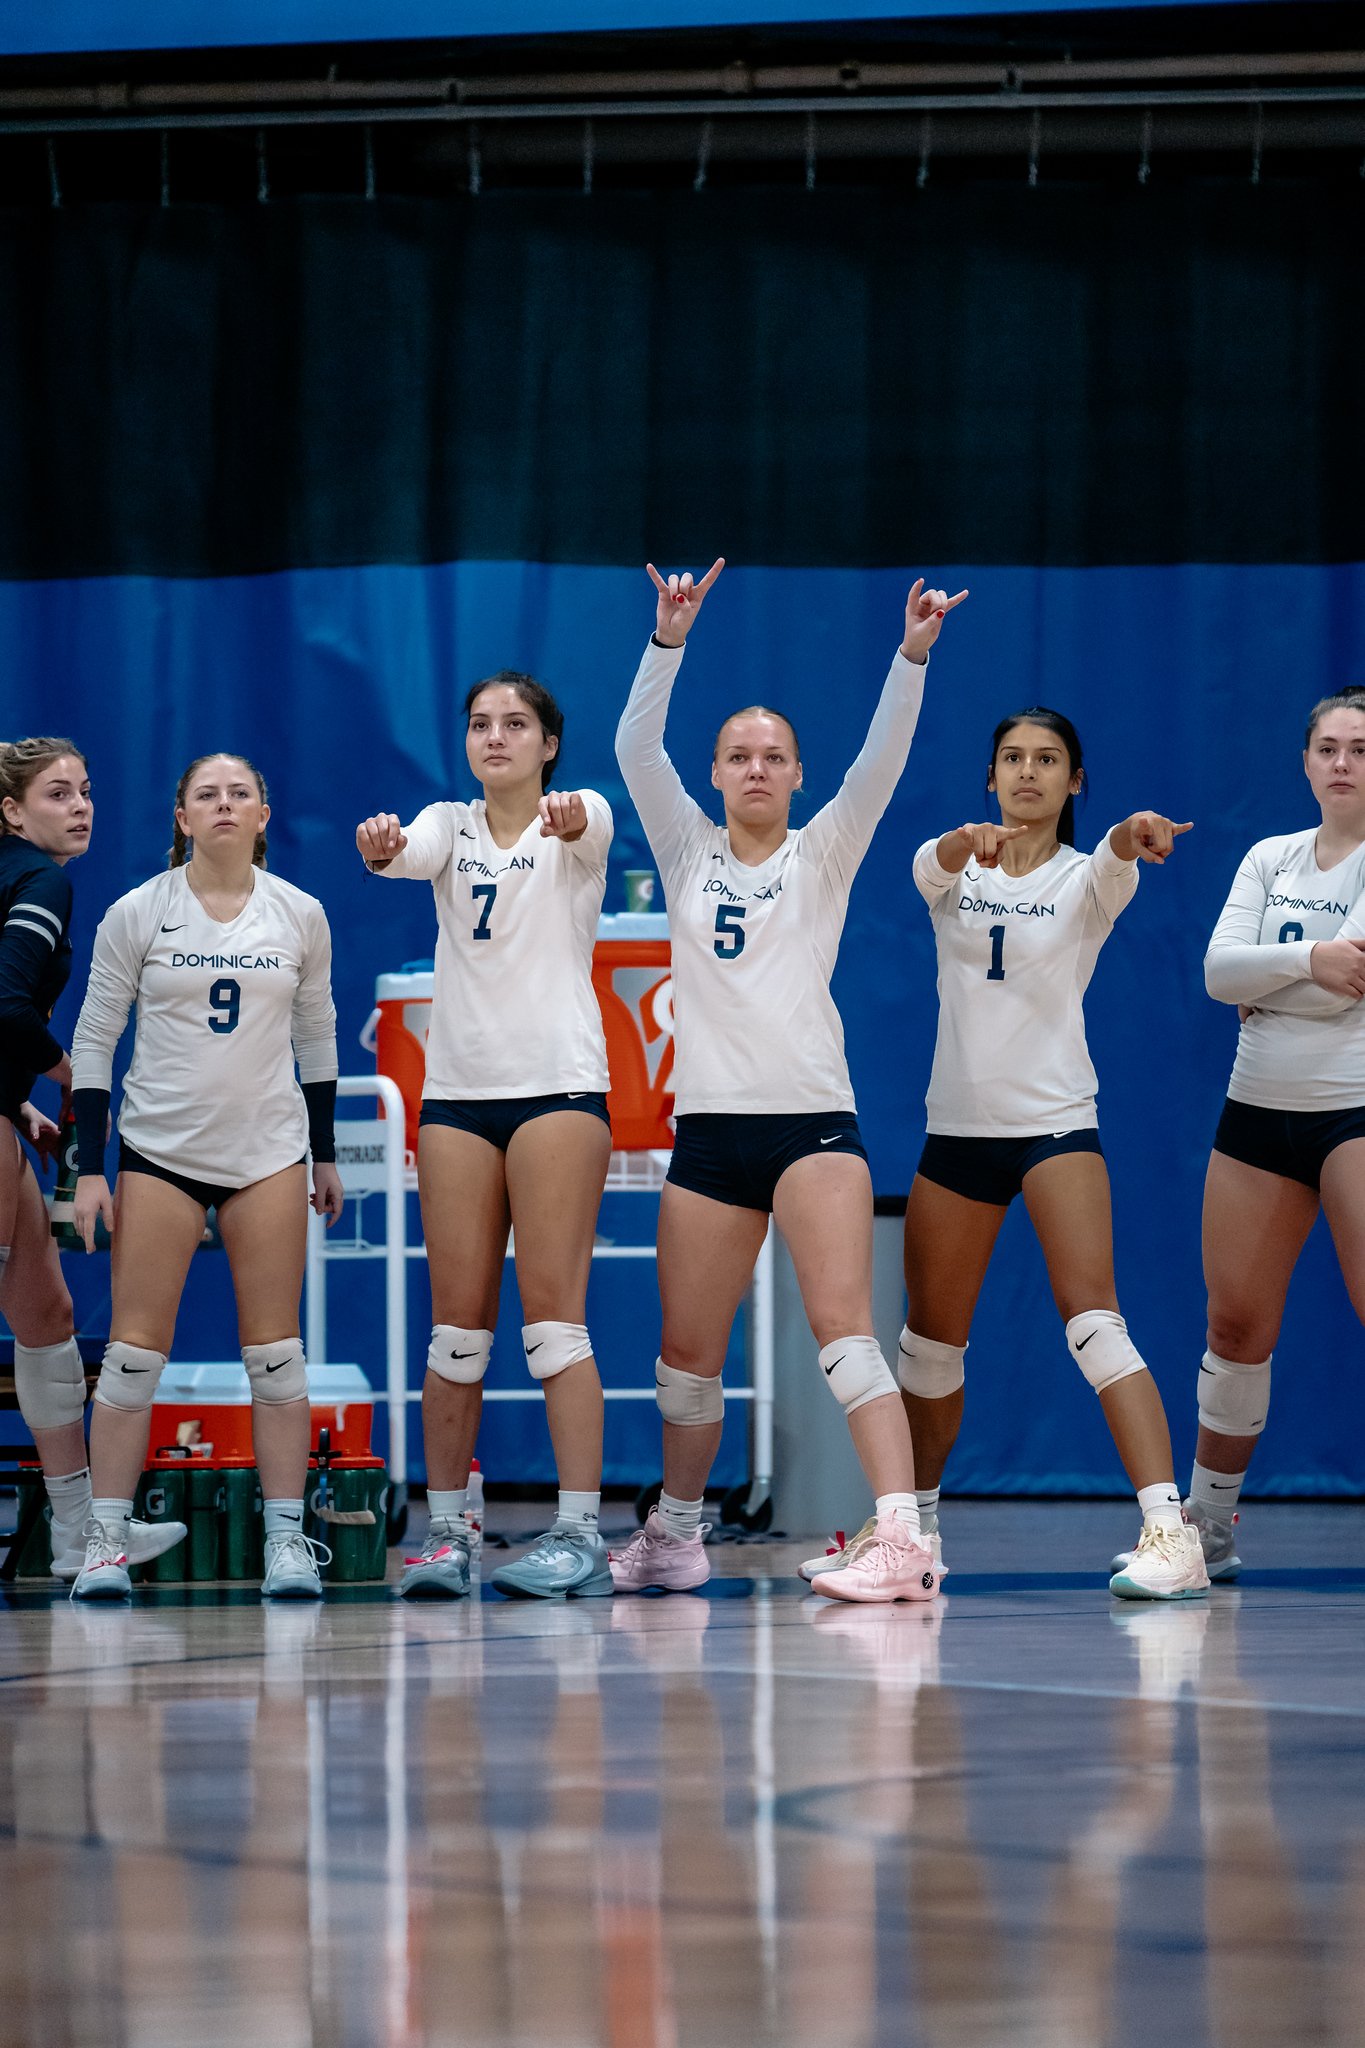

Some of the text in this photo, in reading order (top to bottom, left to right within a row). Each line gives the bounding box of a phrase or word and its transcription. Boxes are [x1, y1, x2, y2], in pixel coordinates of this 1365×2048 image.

[457, 856, 534, 878] DOMINAN
[472, 884, 497, 940] 7
[713, 904, 746, 959] 5
[171, 953, 280, 969] DOMINICAN
[986, 925, 1005, 980] 1
[208, 979, 241, 1034] 9
[335, 1144, 385, 1164] ATORADE
[145, 1487, 166, 1515] G
